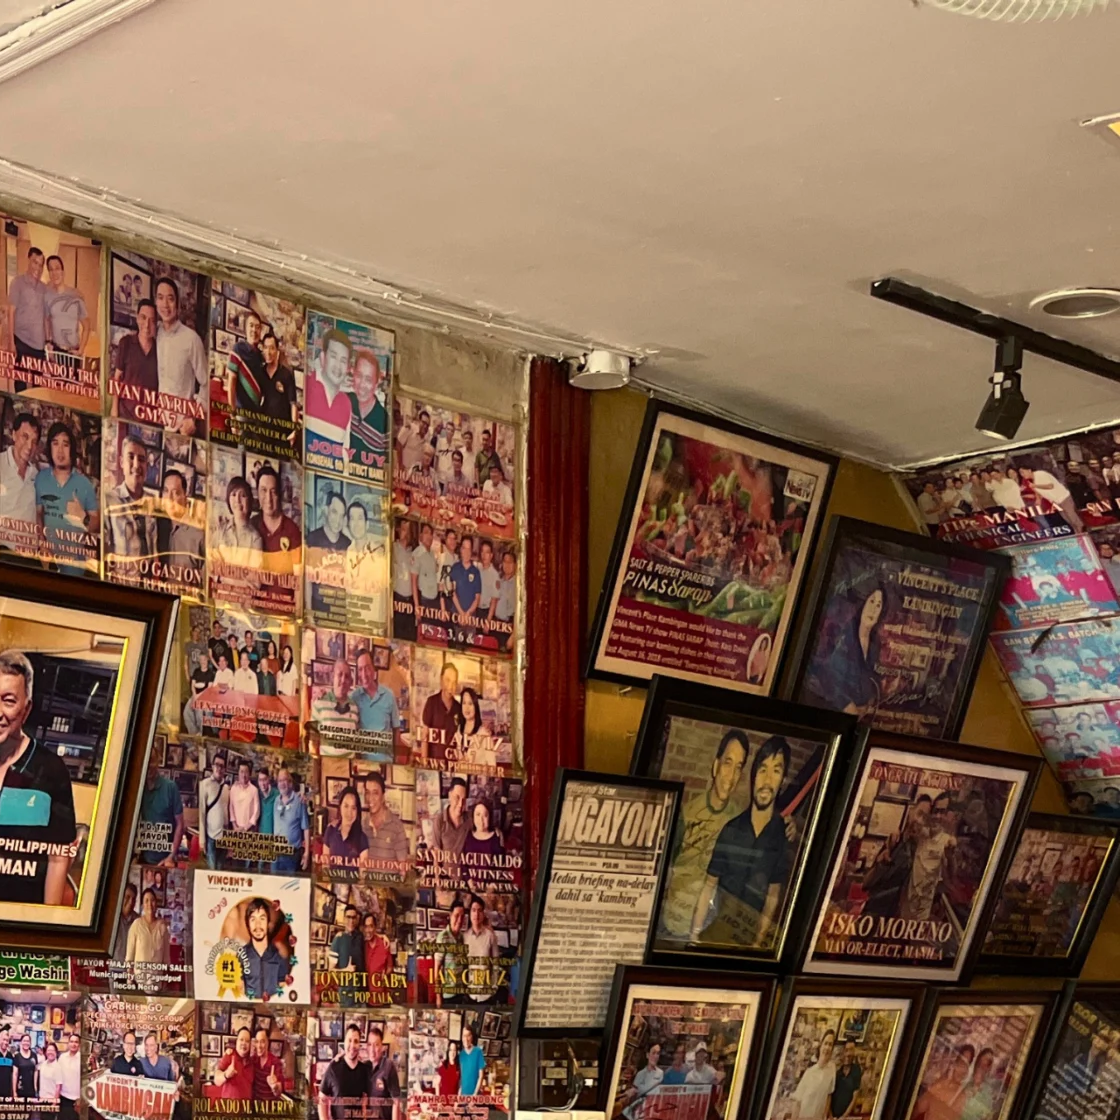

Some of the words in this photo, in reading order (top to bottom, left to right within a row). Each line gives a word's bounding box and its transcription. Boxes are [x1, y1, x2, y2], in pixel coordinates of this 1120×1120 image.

[108, 379, 141, 400] IVAN
[143, 388, 206, 421] MAYRINA
[361, 452, 386, 467] UY
[983, 502, 1064, 527] MANILA
[993, 524, 1072, 547] ENGINEERS
[630, 557, 646, 570] SALT
[654, 562, 680, 578] PEPPER
[623, 571, 668, 593] PINAS
[394, 600, 413, 615] MPD
[415, 604, 450, 622] STATION
[452, 612, 513, 634] COMMANDERS
[597, 784, 617, 796] Star
[557, 796, 662, 848] NGAYON
[578, 873, 615, 890] briefing
[617, 875, 656, 892] na-delay
[555, 888, 580, 902] dahil
[581, 892, 593, 903] sa
[828, 912, 874, 937] ISKO
[876, 916, 953, 943] MORENO
